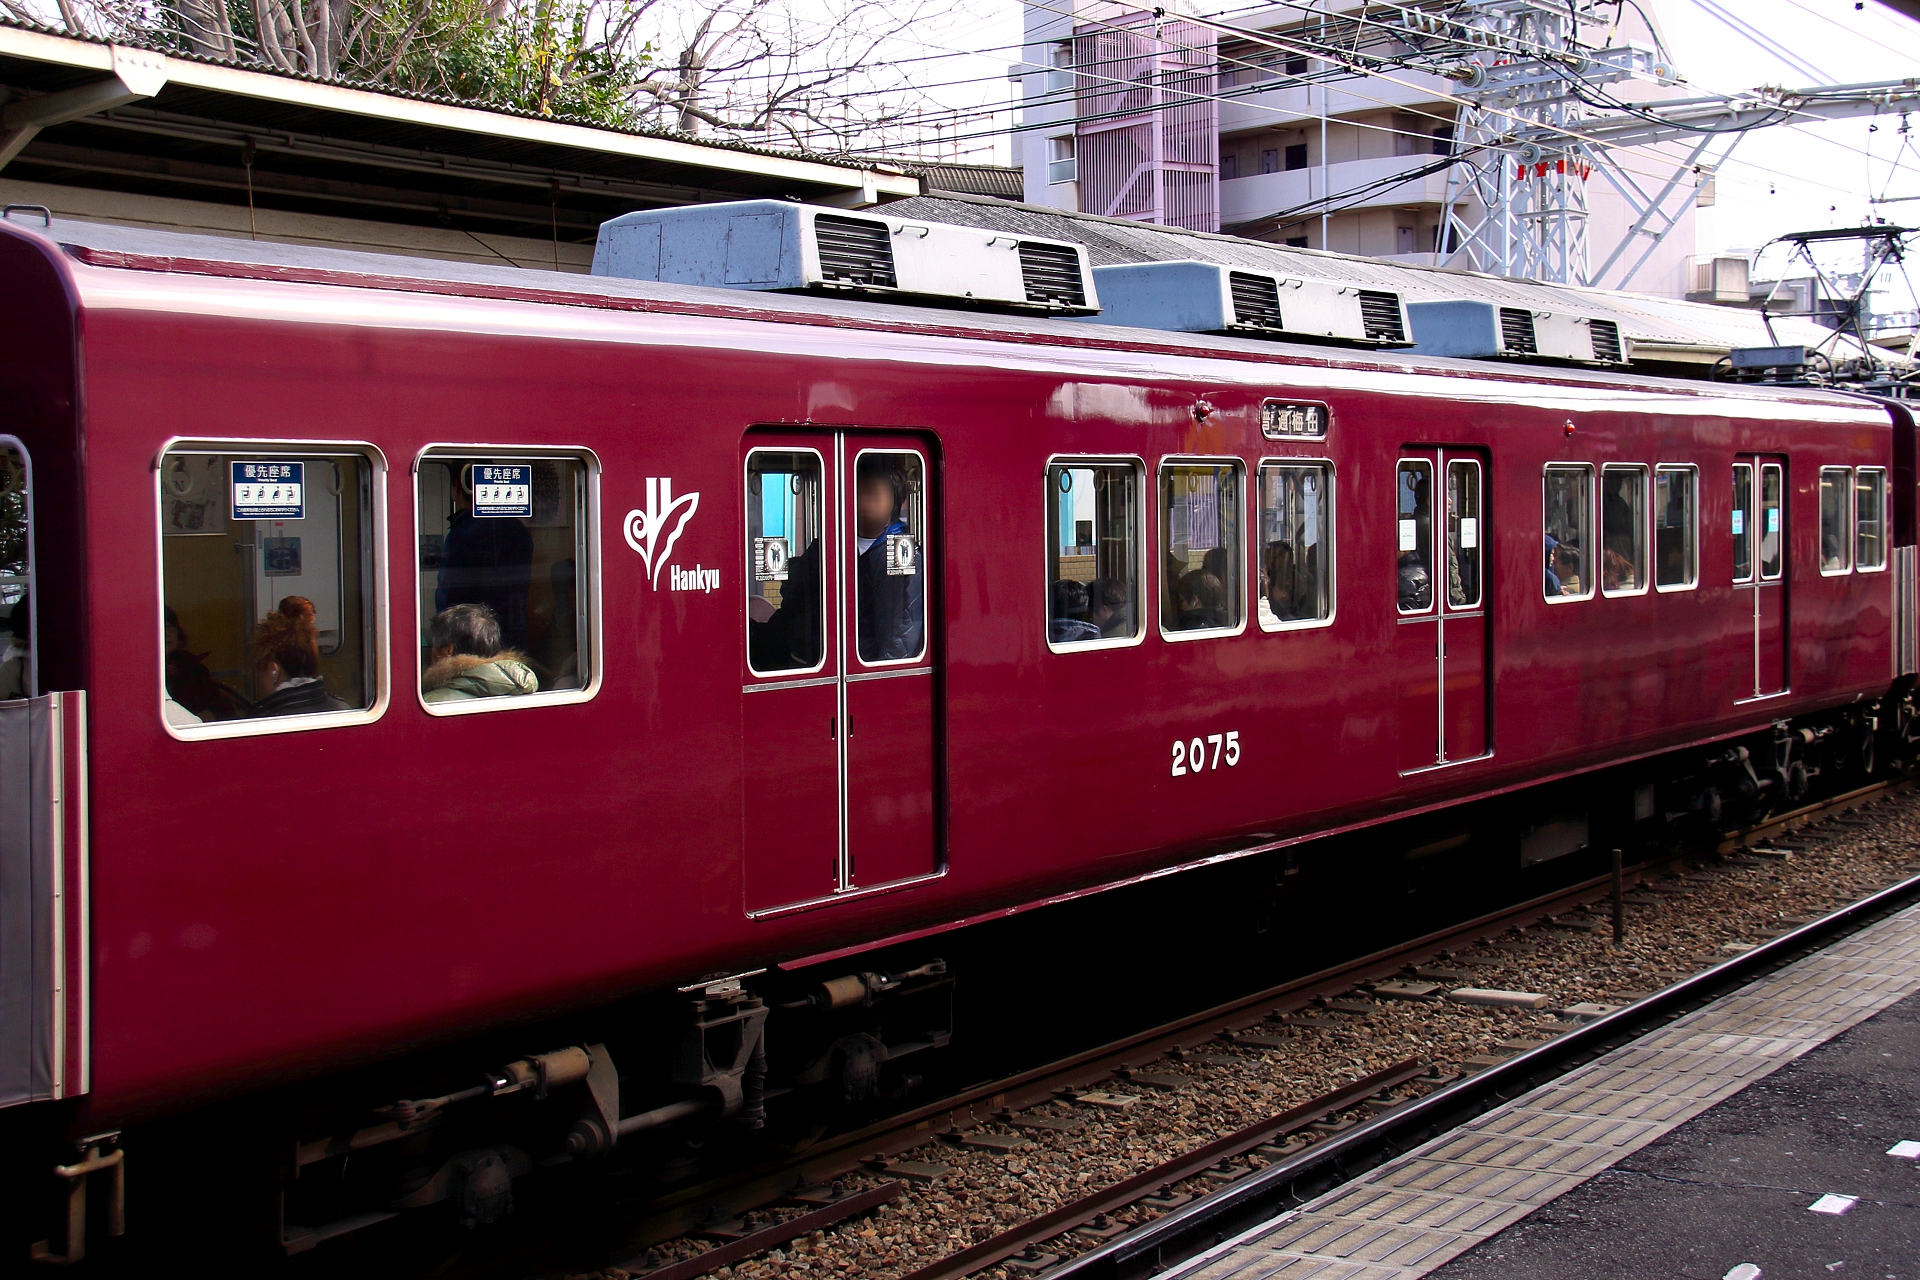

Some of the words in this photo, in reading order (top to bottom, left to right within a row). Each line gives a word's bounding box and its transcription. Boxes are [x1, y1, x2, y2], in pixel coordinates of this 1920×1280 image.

[1292, 411, 1319, 432] 梅田
[244, 465, 291, 478] 優先座席
[483, 467, 521, 480] 優先座席
[670, 563, 720, 594] Hankyu
[1171, 730, 1240, 777] 2075
